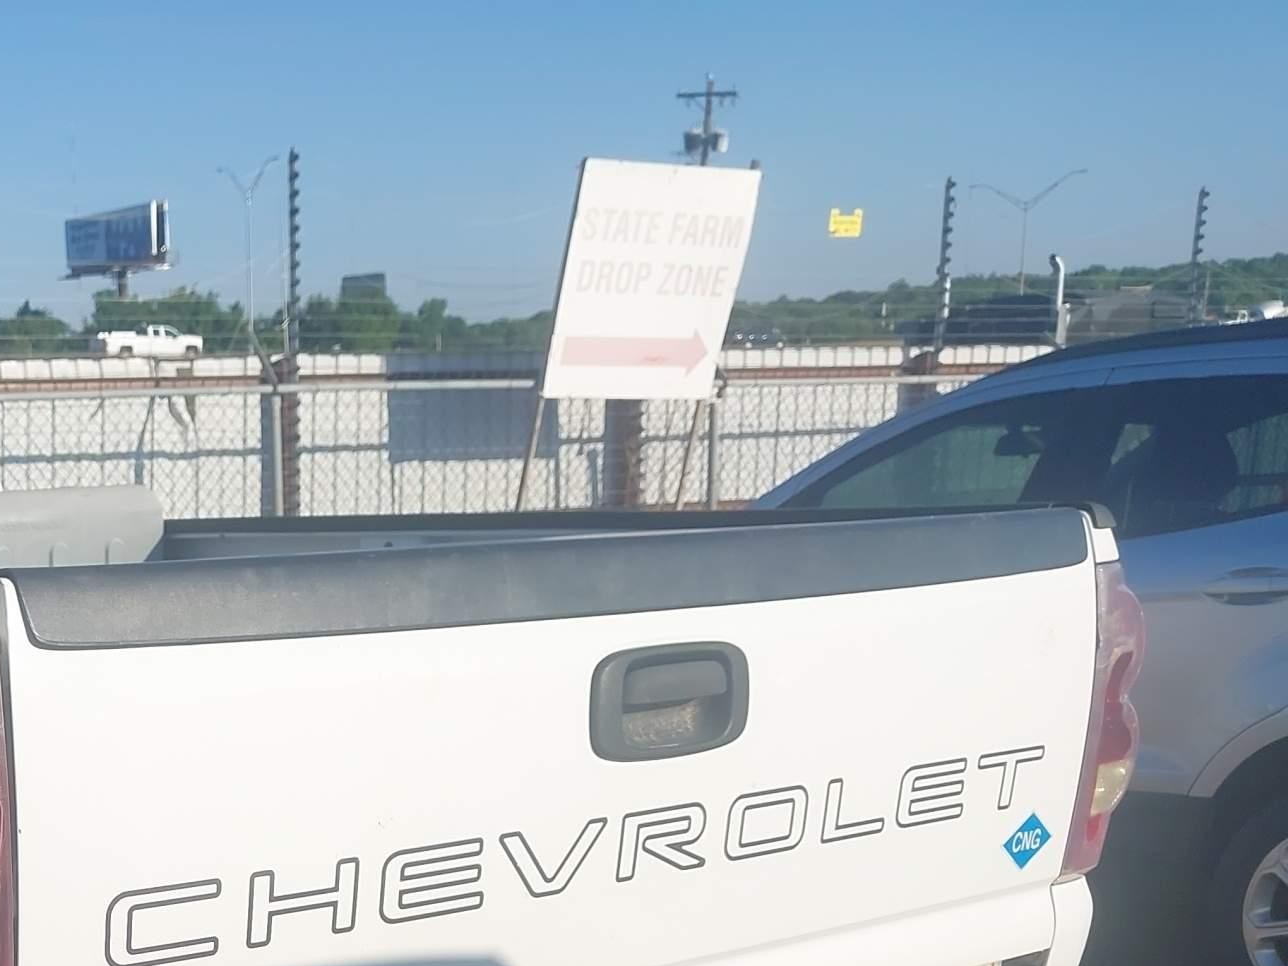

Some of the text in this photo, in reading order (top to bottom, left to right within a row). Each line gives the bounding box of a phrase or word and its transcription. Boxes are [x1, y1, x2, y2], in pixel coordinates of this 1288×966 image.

[582, 207, 746, 249] STATE FARM
[576, 258, 730, 297] DROP ZONE
[1012, 828, 1042, 853] CNG
